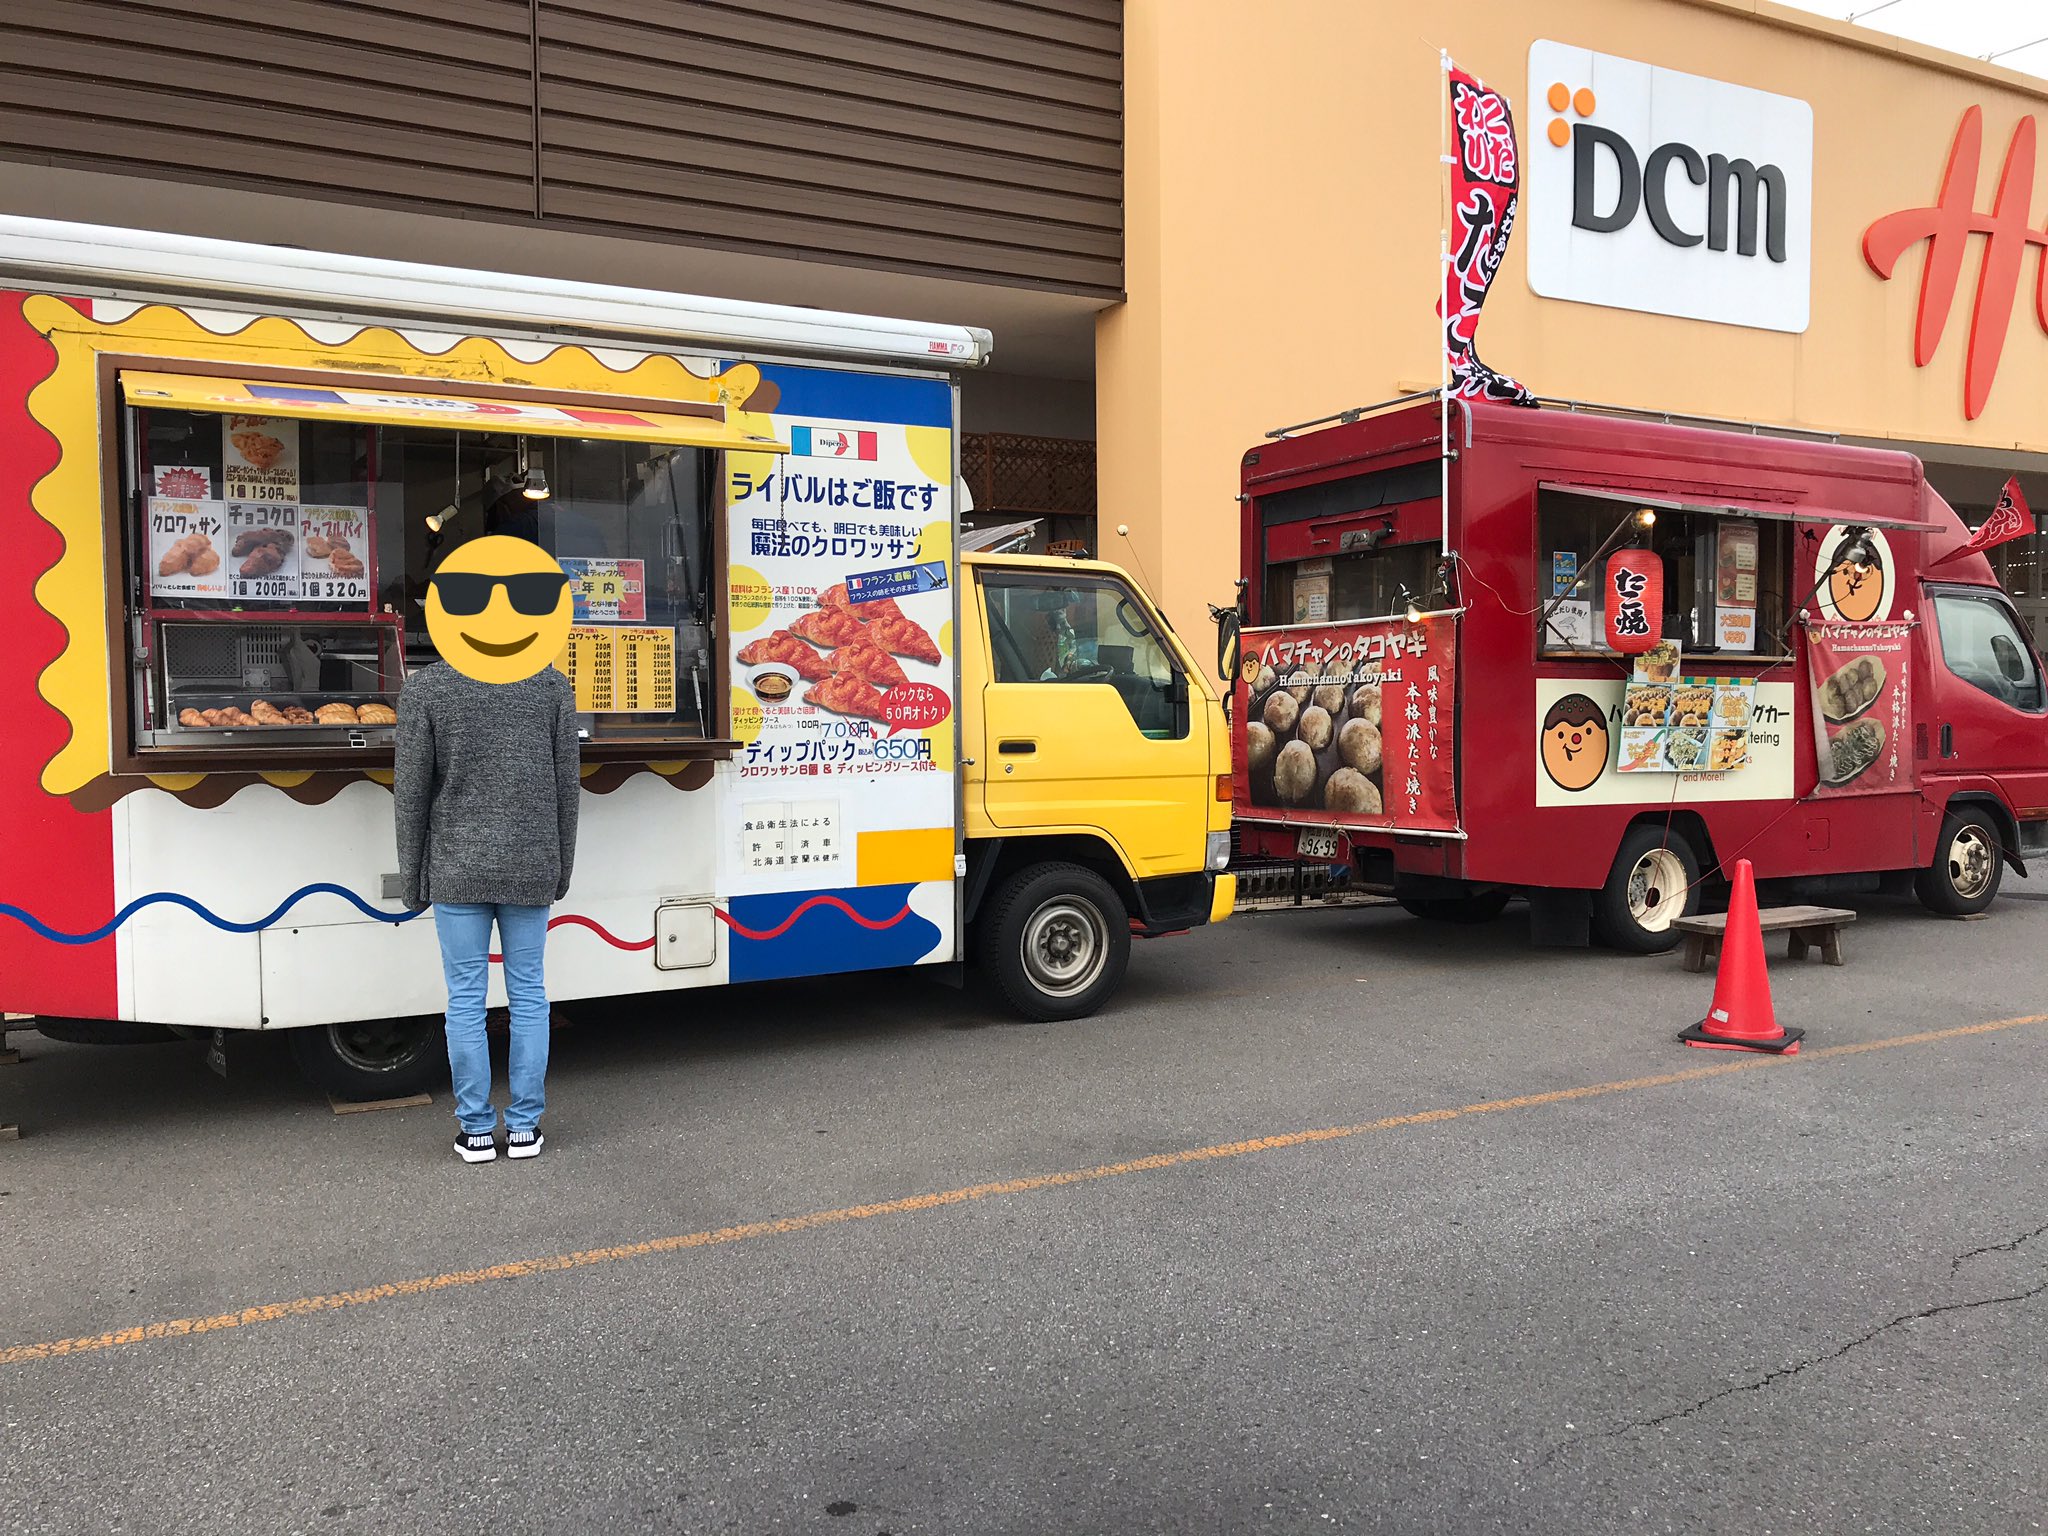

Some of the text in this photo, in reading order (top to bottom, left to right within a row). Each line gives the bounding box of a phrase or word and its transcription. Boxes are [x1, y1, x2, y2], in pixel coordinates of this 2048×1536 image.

[1862, 104, 2048, 420] H
[930, 341, 948, 350] FIAMMA
[253, 486, 284, 500] 150円
[732, 473, 938, 511] ライバルはご飯です
[229, 505, 295, 526] チョコクロ
[153, 514, 221, 535] クロワッサン
[301, 520, 363, 538] アップルパイ
[752, 518, 922, 536] 毎日食べても、明日でも美味しい
[751, 532, 922, 559] 魔法のクロワッサン
[232, 581, 247, 596] 1個
[256, 582, 286, 596] 200円
[302, 582, 320, 597] 1個
[326, 582, 366, 598] 320円
[582, 581, 615, 594] 年内
[1614, 567, 1649, 635] たこ焼
[1821, 624, 1909, 639] ハマチャンのタコヤキ
[1261, 630, 1427, 667] ハマチャンのタコヤキ
[1279, 668, 1402, 686] HamachannoTakoyaki
[889, 687, 934, 702] パックなら
[886, 706, 945, 720] 50円オトク!
[1427, 664, 1440, 759] 風味豊かな
[796, 720, 819, 729] 100円
[822, 721, 870, 738] 700円
[1749, 731, 1780, 746] tering
[747, 740, 855, 763] ディップパック
[875, 738, 931, 760] 650円
[1405, 682, 1422, 814] 本格派たこ焼き
[740, 761, 937, 777] クロワッサン6個 & ディッピングソース付き
[1683, 773, 1724, 781] and More!!
[744, 817, 830, 831] 食品衛生法による
[752, 838, 831, 852] 許可済車
[1306, 839, 1337, 856] 96-99
[468, 1135, 494, 1147] PUMA
[509, 1132, 534, 1142] PUMA
